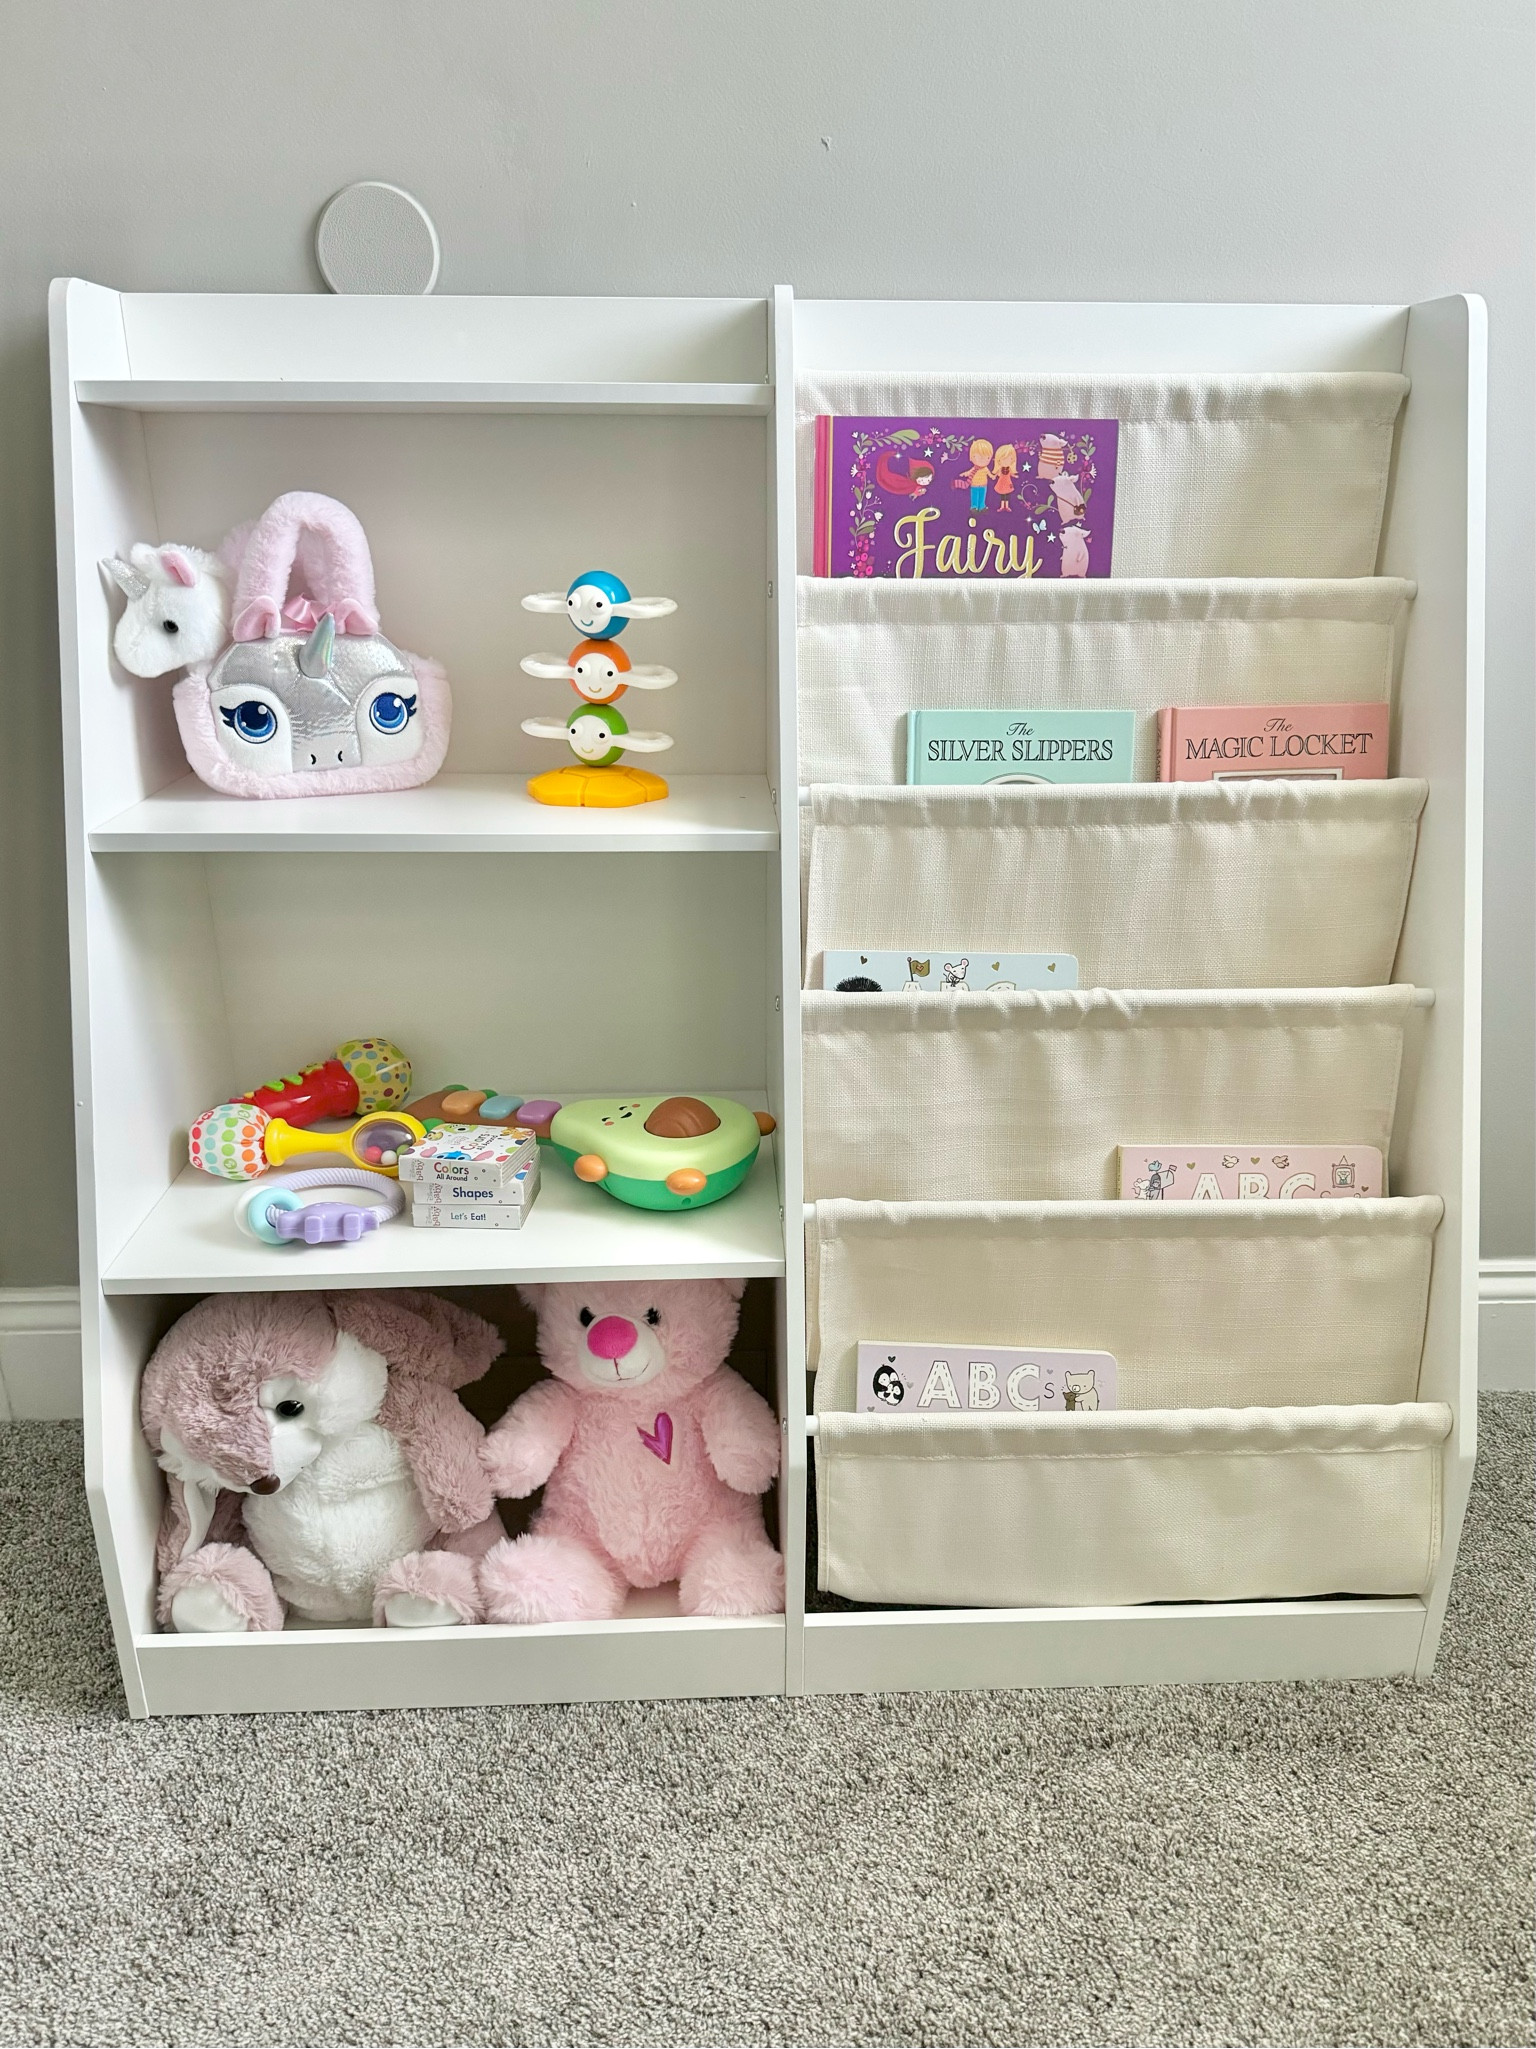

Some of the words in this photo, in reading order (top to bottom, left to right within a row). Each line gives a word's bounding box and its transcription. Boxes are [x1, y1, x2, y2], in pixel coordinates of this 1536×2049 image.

[894, 506, 1043, 578] Fairy
[1006, 722, 1034, 736] The
[1263, 718, 1293, 732] The
[927, 739, 1007, 762] SILVER
[1011, 738, 1114, 762] SLIPPERS
[1185, 736, 1264, 760] MAGIC
[1269, 732, 1374, 758] LOCKET
[433, 1161, 470, 1175] Colors
[446, 1174, 468, 1182] Around
[452, 1186, 494, 1200] Shapes
[450, 1212, 468, 1220] Let's
[470, 1212, 487, 1221] Eat!
[916, 1360, 1055, 1411] ABCs
